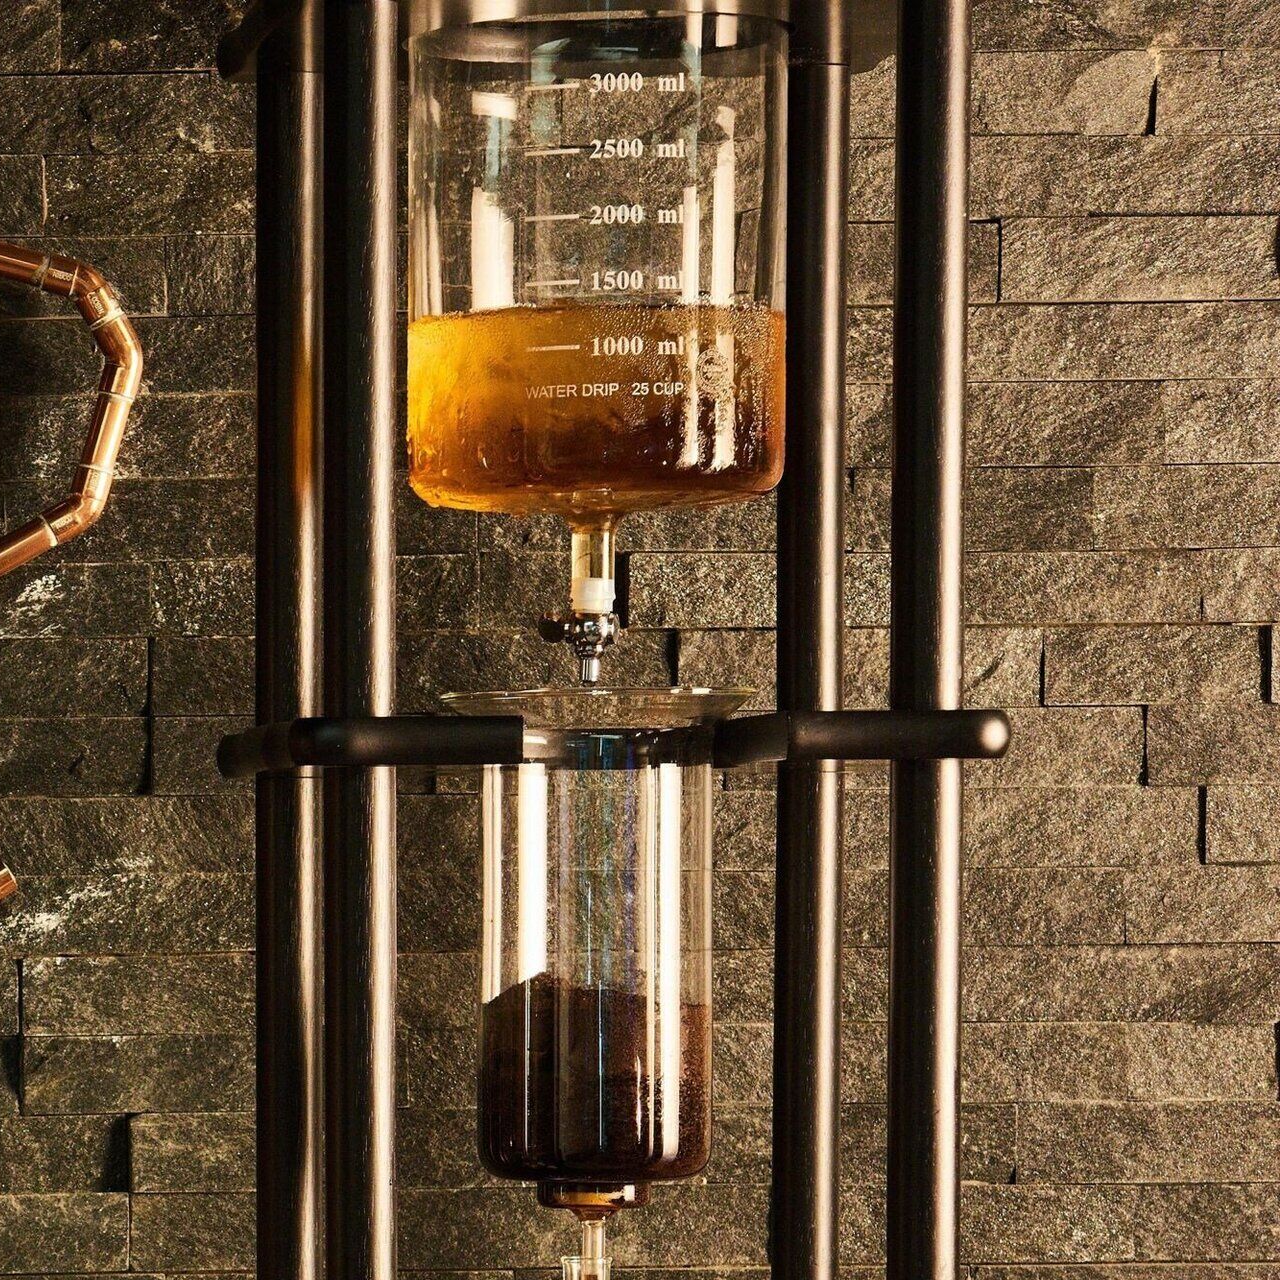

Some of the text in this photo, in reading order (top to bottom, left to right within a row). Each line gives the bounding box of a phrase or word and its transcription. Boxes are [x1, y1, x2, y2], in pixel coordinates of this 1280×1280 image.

[589, 72, 685, 93] 3000 ml
[589, 138, 685, 159] 2500 ml
[589, 205, 684, 225] 2000 ml
[52, 271, 74, 282] NIBCO
[591, 270, 683, 290] 1500 ml
[91, 296, 105, 315] NIBCO
[590, 336, 685, 357] 1000 ml
[525, 382, 684, 398] WATER DRIP 25 CUP
